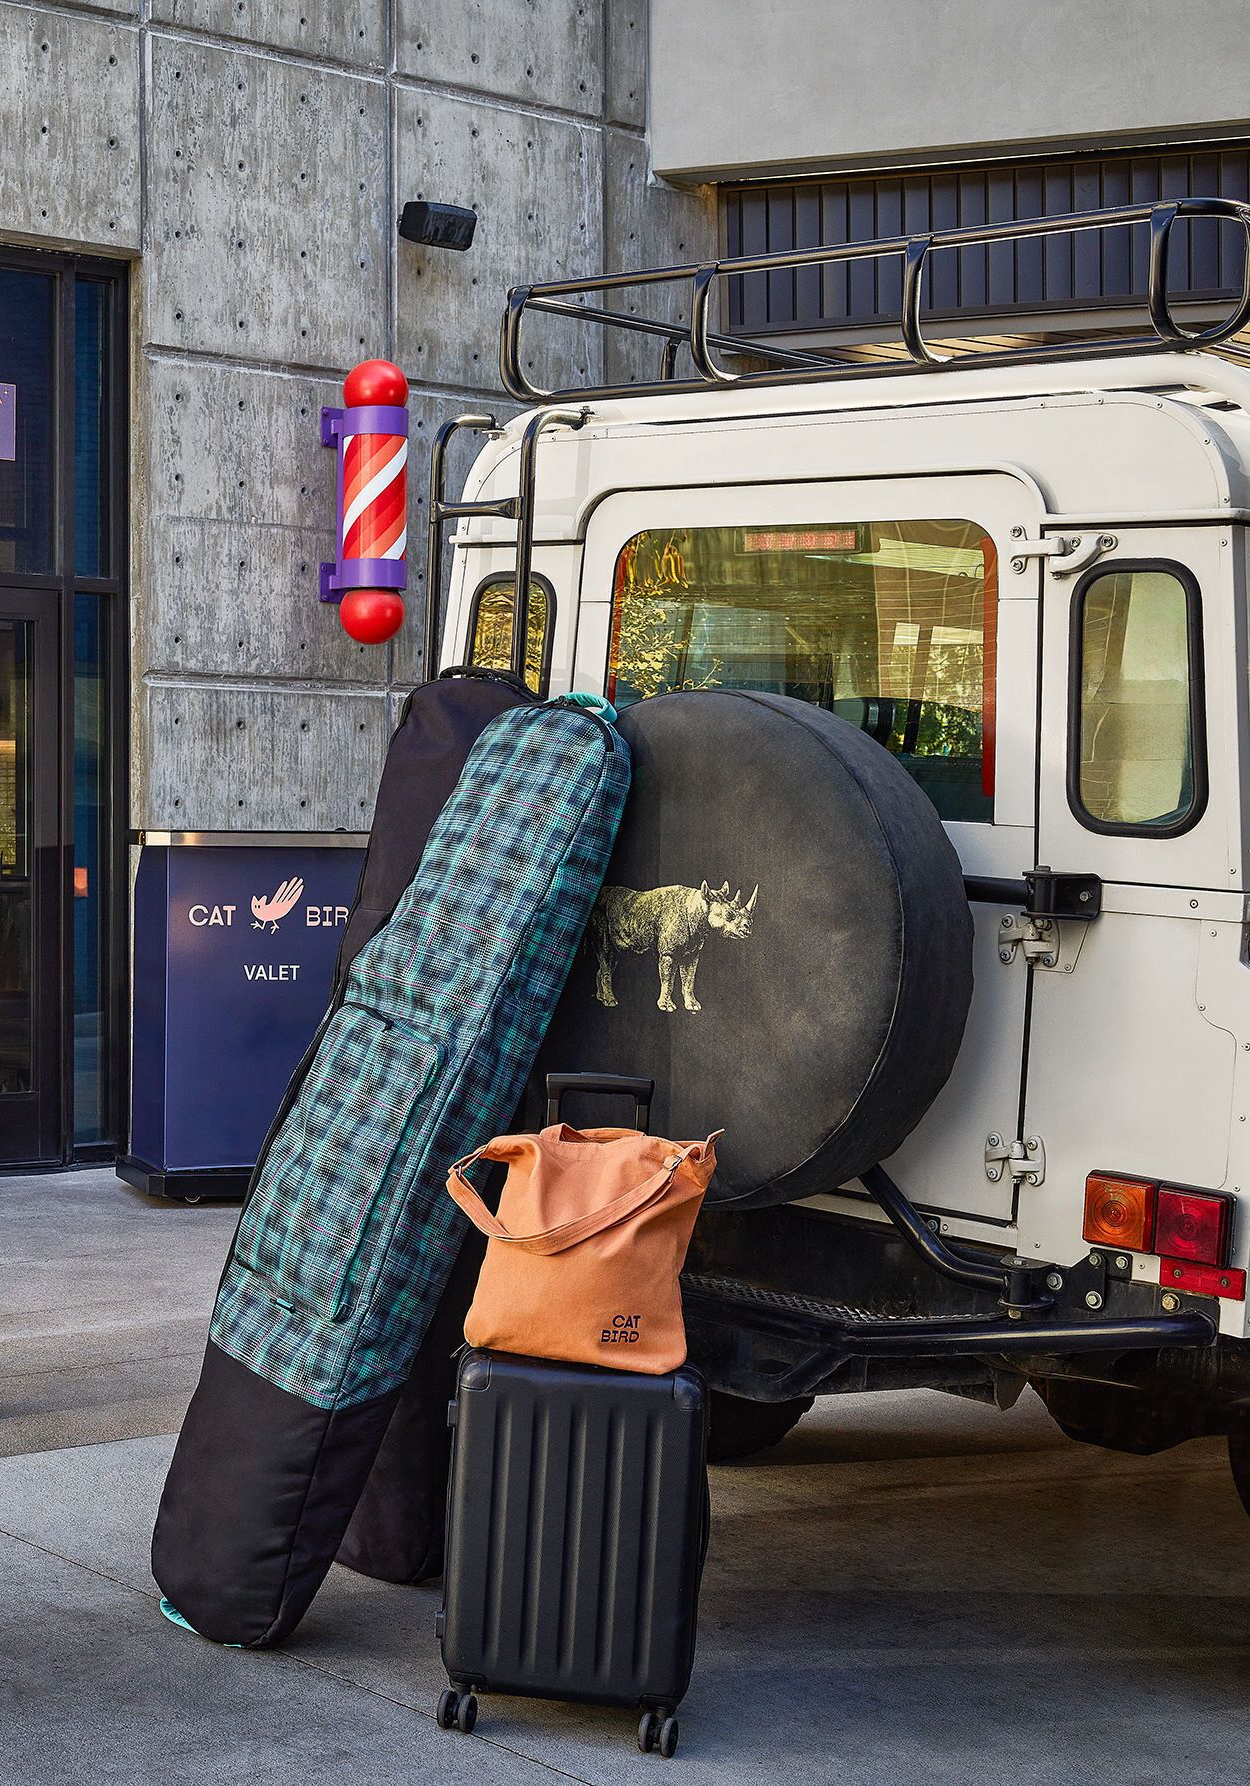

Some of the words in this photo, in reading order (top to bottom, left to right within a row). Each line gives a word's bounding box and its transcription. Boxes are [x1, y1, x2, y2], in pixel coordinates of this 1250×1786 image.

[188, 904, 237, 926] CAT
[306, 906, 349, 927] BIR
[243, 964, 300, 981] VALET
[612, 1315, 642, 1328] CAT
[600, 1329, 640, 1343] BIRD
